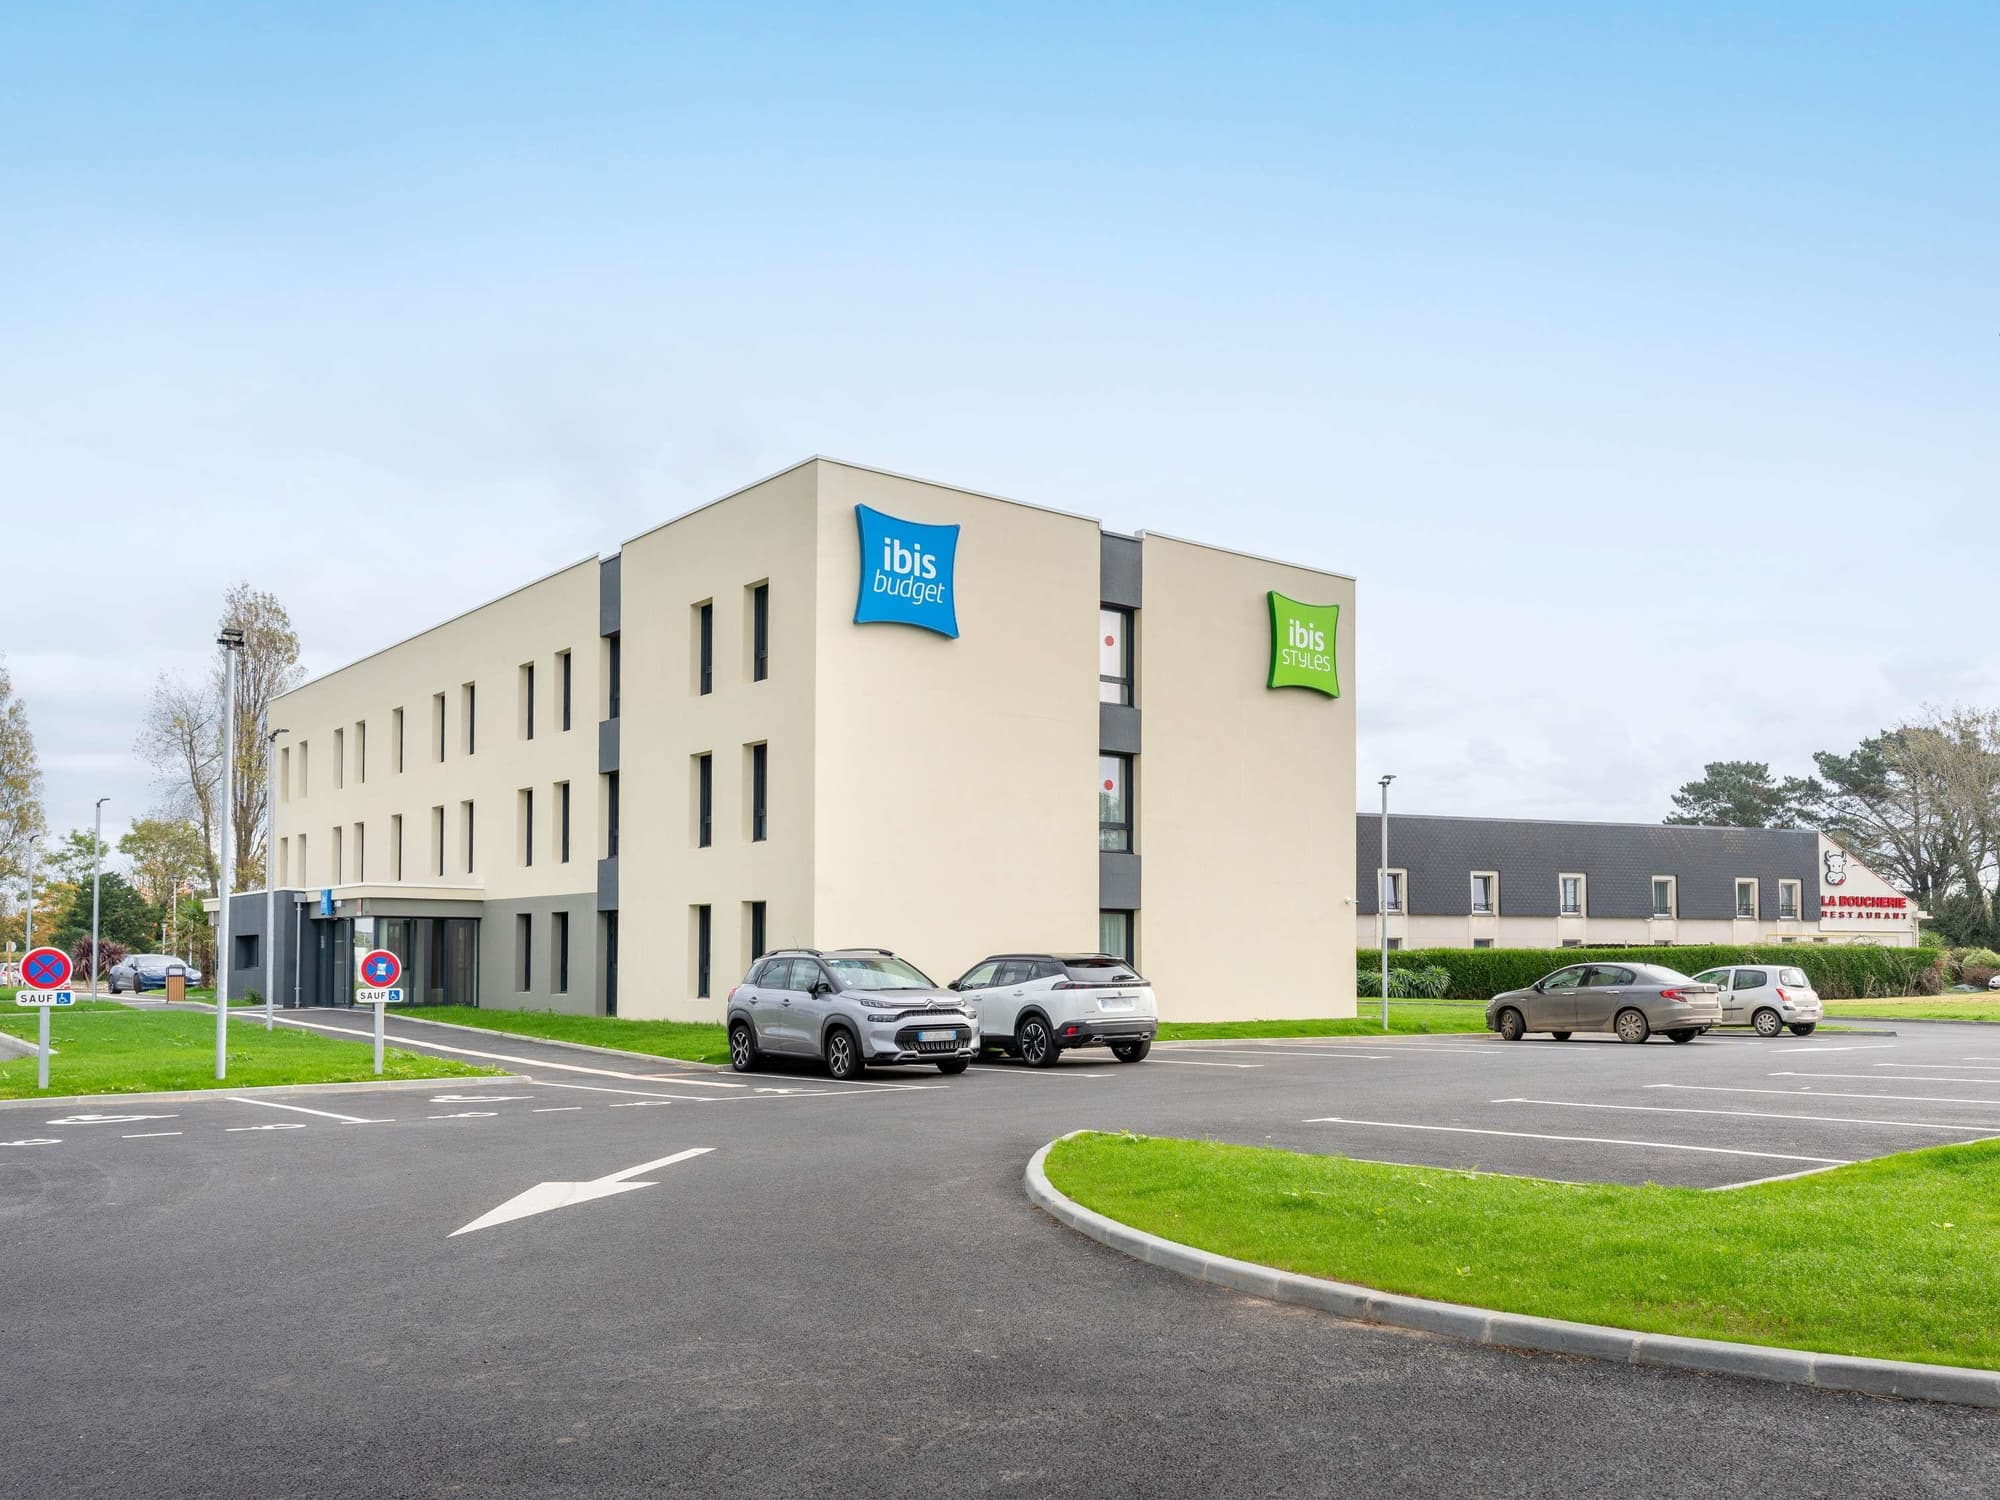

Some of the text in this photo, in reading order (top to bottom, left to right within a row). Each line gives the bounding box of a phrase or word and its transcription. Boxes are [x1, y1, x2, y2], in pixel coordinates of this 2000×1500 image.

[883, 537, 937, 579] ibis
[873, 568, 945, 605] budget
[1288, 618, 1325, 652] ibis
[1820, 895, 1907, 909] LA BOUCHERIE
[1821, 910, 1908, 920] RESTAURANT
[20, 994, 54, 1003] SAUF
[360, 991, 387, 1000] SAUF
